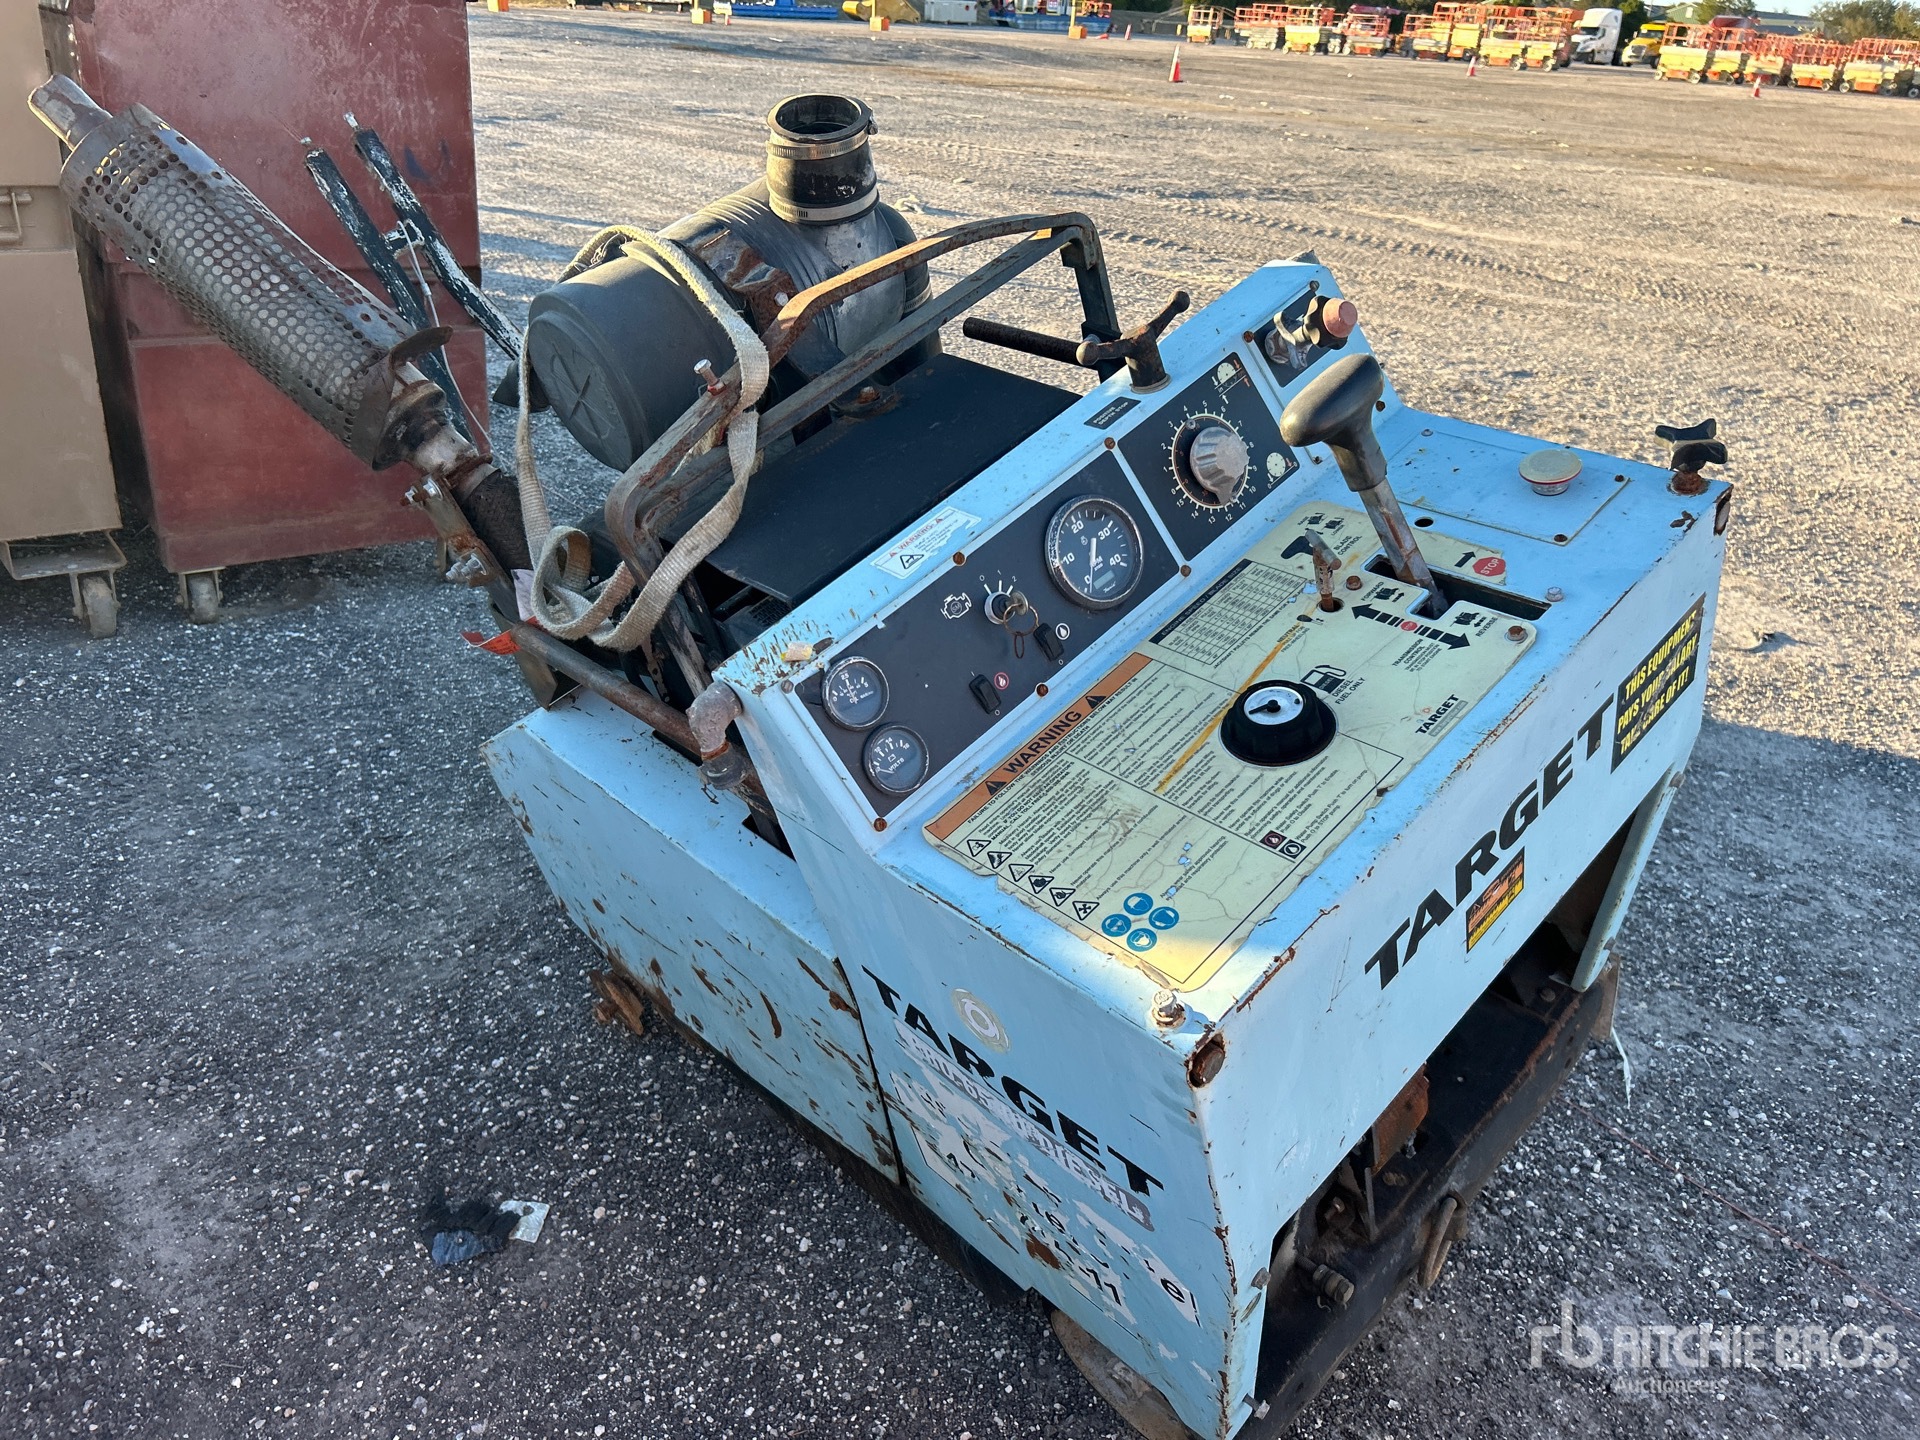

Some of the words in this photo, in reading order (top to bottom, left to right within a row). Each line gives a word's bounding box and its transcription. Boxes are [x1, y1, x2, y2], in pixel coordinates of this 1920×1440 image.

[1176, 499, 1184, 508] 15
[1191, 510, 1199, 519] 14
[1072, 521, 1084, 534] 20
[1208, 516, 1216, 524] 13
[1226, 514, 1233, 522] 12
[898, 524, 933, 550] WARNING
[1098, 527, 1111, 540] 30
[1334, 535, 1353, 550] BLADE
[1338, 535, 1362, 555] CONTROL
[1063, 552, 1075, 565] 10
[1110, 553, 1121, 566] 40
[1481, 558, 1499, 575] STOP
[1160, 614, 1186, 635] ENGINE
[1184, 597, 1206, 615] SPEED
[1207, 578, 1228, 595] BLADE
[1226, 567, 1241, 578] SIZE
[1360, 580, 1384, 601] FORWARD
[1276, 623, 1299, 643] NEUTRAL
[1475, 615, 1498, 637] REVERSE
[1392, 637, 1423, 666] TRANSMISSION
[1403, 644, 1425, 664] CONTROL
[1624, 663, 1646, 703] THIS
[1646, 608, 1696, 679] EQUIPMENT
[1331, 678, 1354, 698] DIESEL
[1334, 689, 1352, 705] FUEL
[1348, 676, 1366, 692] ONLY
[1617, 695, 1640, 736] PAYS
[1664, 632, 1697, 682] SALARY
[1665, 678, 1676, 705] OF
[1676, 663, 1689, 693] IT!
[1414, 693, 1459, 737] TARGET
[967, 805, 989, 823] FAILURE
[994, 782, 1015, 800] FOLLOW
[1014, 774, 1025, 783] THE
[1023, 753, 1049, 774] WARNINGS
[1048, 744, 1059, 754] AND
[1089, 704, 1106, 718] BELOW
[1105, 695, 1116, 705] MAY
[1114, 681, 1133, 696] RESULT
[1002, 708, 1084, 775] WARNING
[1030, 758, 1051, 776] SERIOUS
[1050, 744, 1067, 759] INJURY
[1073, 725, 1090, 739] DEATH
[1162, 784, 1177, 797] Always
[1181, 767, 1195, 779] caution
[1194, 758, 1204, 768] when
[1203, 750, 1214, 759] lifting
[1177, 788, 1187, 796] only
[1185, 781, 1194, 789] from
[1048, 862, 1062, 873] Never
[1067, 840, 1086, 856] damaged
[1084, 828, 1098, 840] blades
[1364, 692, 1614, 990] TARGET
[1095, 886, 1111, 900] Always
[1123, 858, 1140, 873] machine
[1138, 850, 1149, 859] only
[1150, 839, 1160, 848] well
[1158, 823, 1177, 840] ventilated
[1173, 875, 1184, 885] wear
[1182, 864, 1196, 876] safety
[1193, 848, 1212, 865] approved
[1182, 875, 1192, 883] and
[1190, 857, 1211, 876] respiratory
[861, 965, 1164, 1197] TARGET
